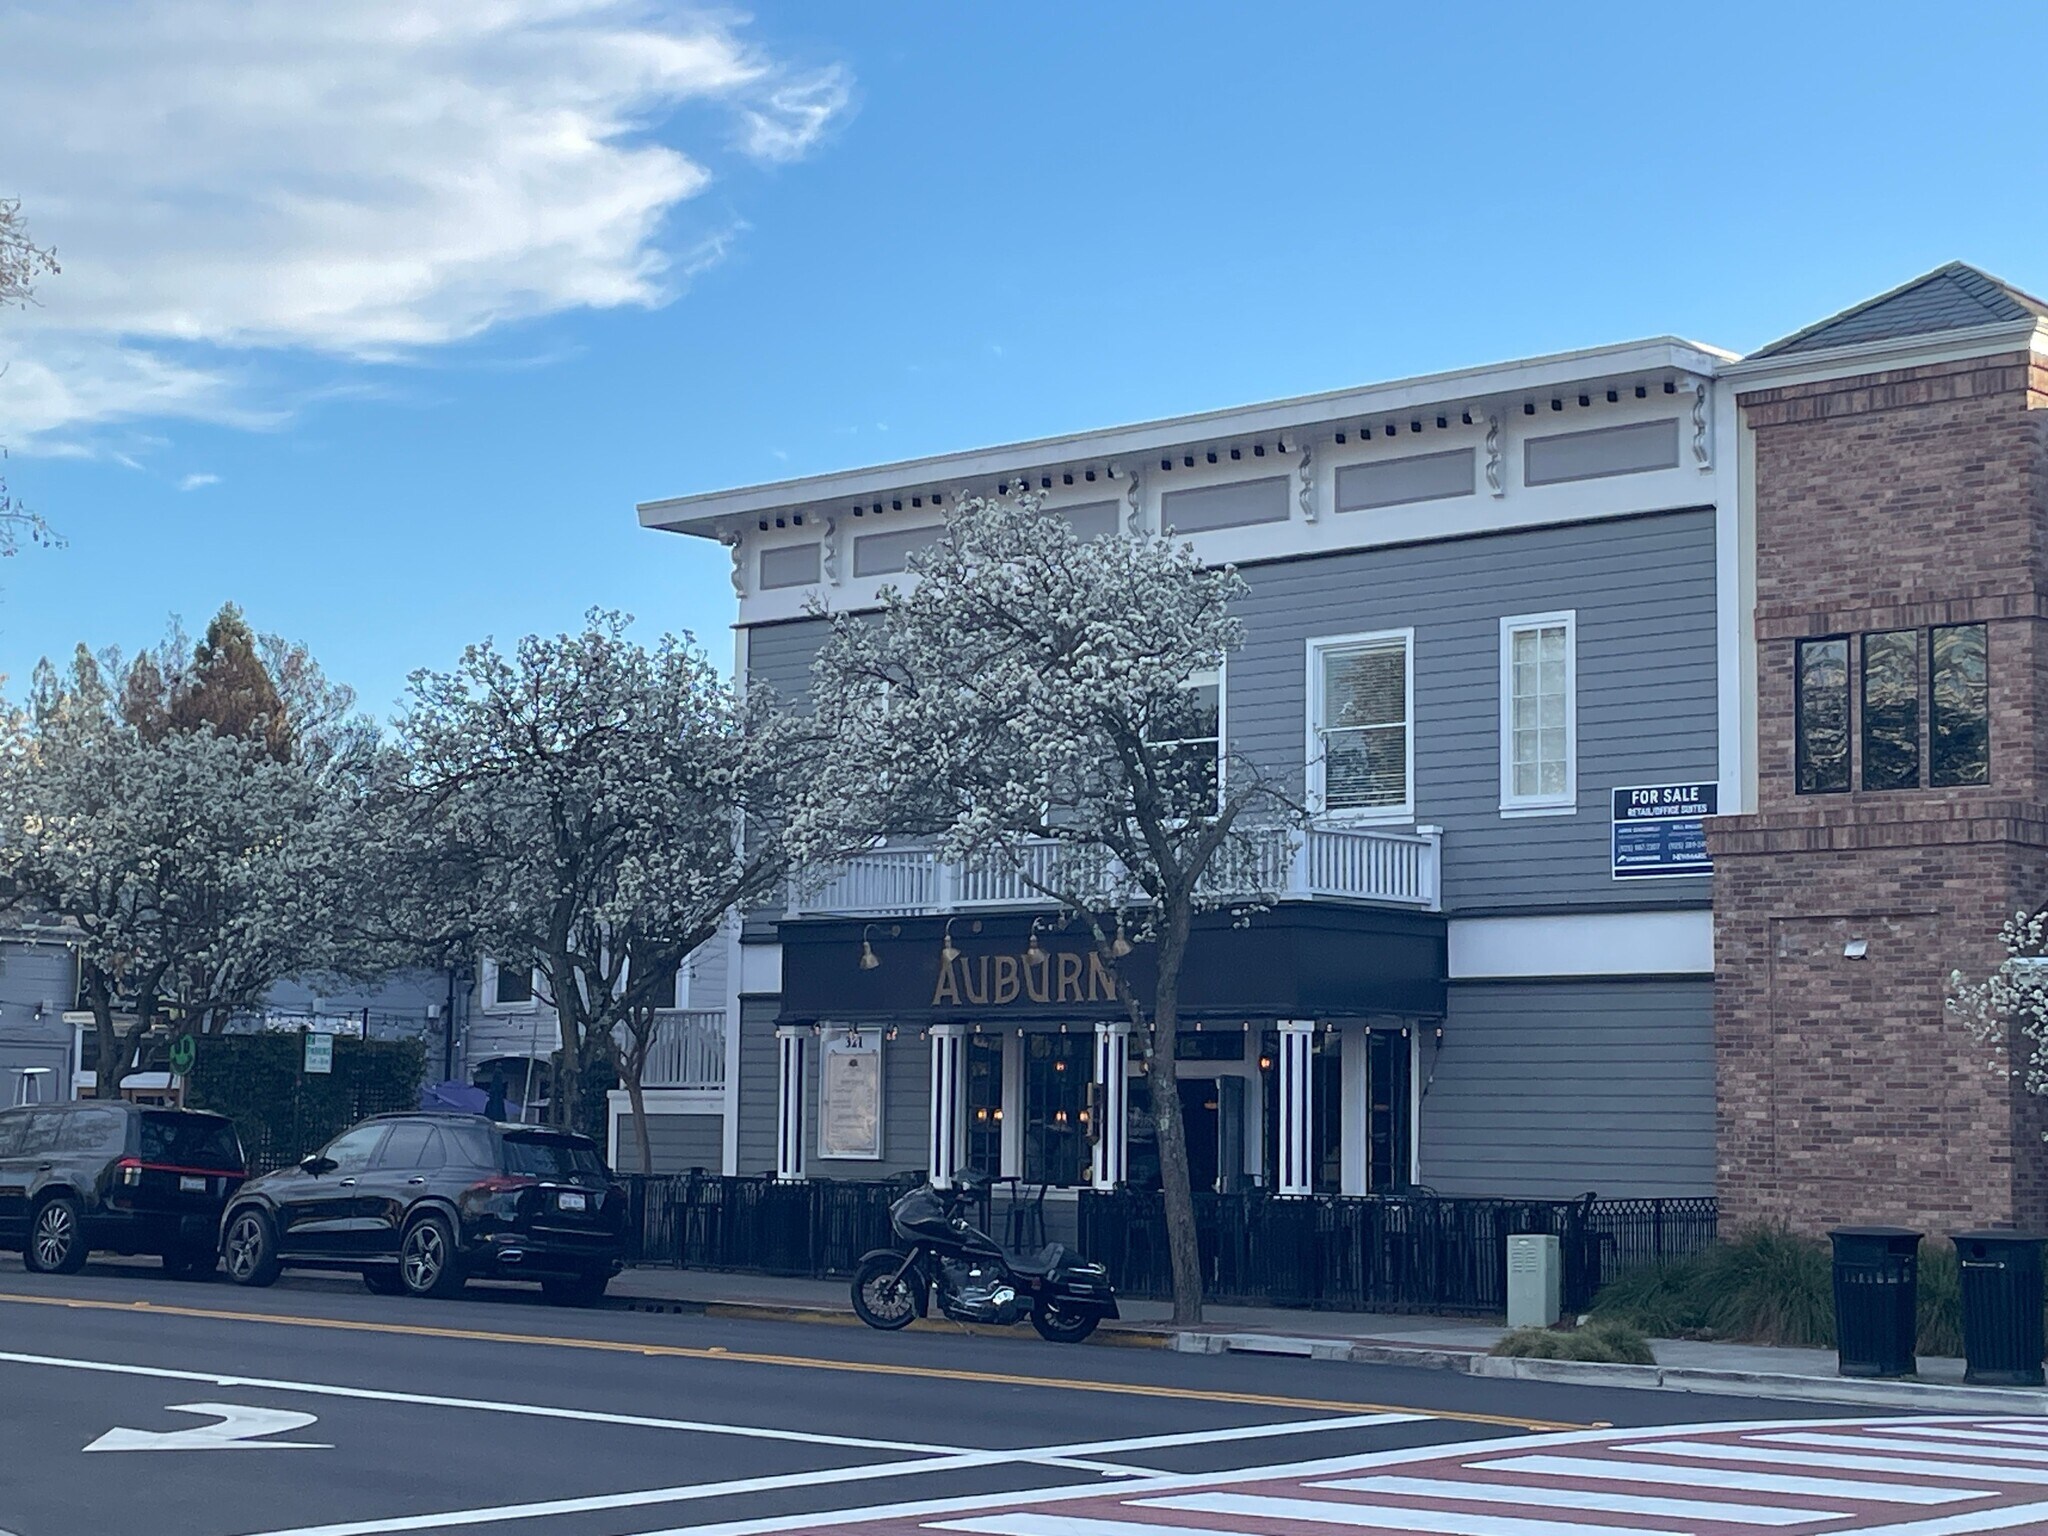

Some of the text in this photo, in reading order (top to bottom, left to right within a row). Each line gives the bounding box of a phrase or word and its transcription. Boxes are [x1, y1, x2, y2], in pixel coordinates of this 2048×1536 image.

[1631, 787, 1699, 805] FOR SALE
[932, 951, 1118, 1006] AUBURN
